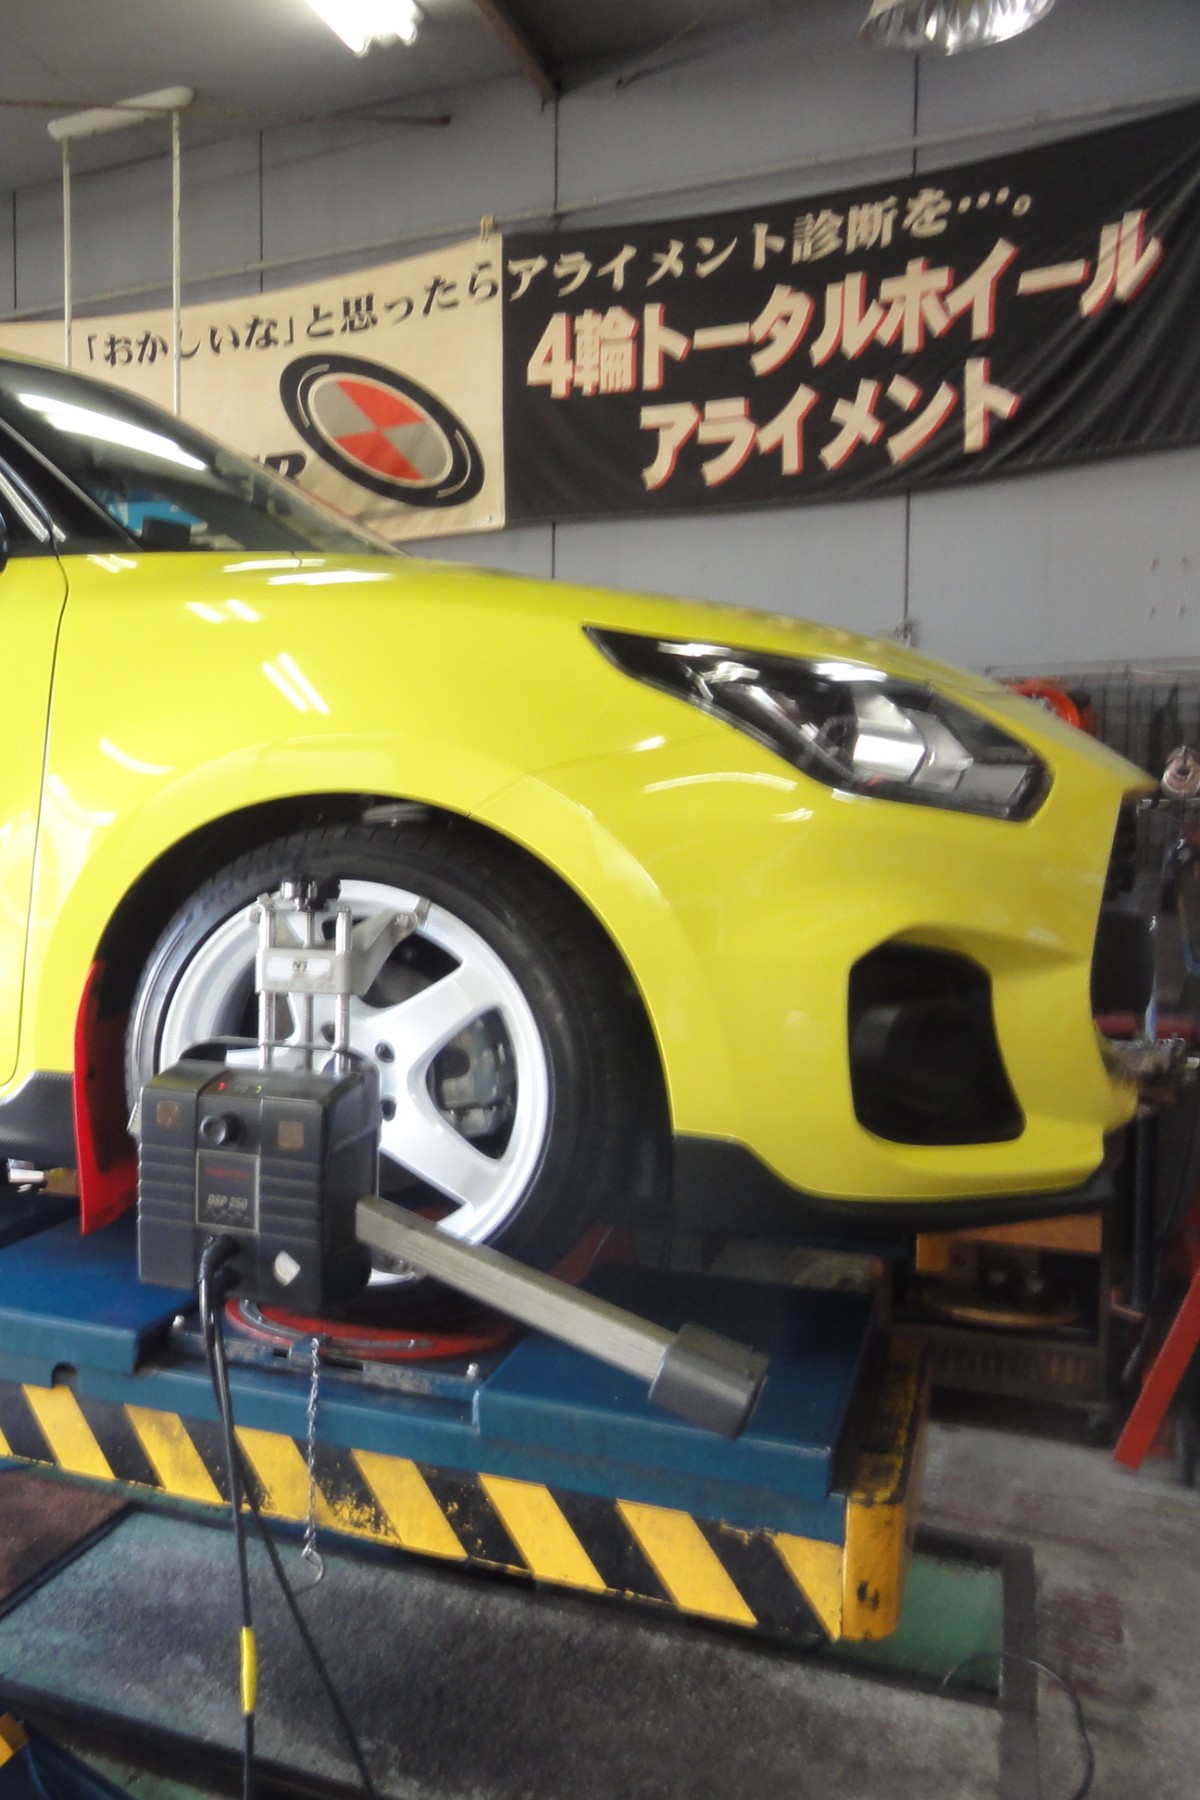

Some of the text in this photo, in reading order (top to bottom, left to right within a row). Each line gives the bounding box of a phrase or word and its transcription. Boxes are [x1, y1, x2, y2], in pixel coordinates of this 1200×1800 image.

[527, 209, 1162, 398] 4輪トータルホイール
[640, 357, 1019, 490] アライメント
